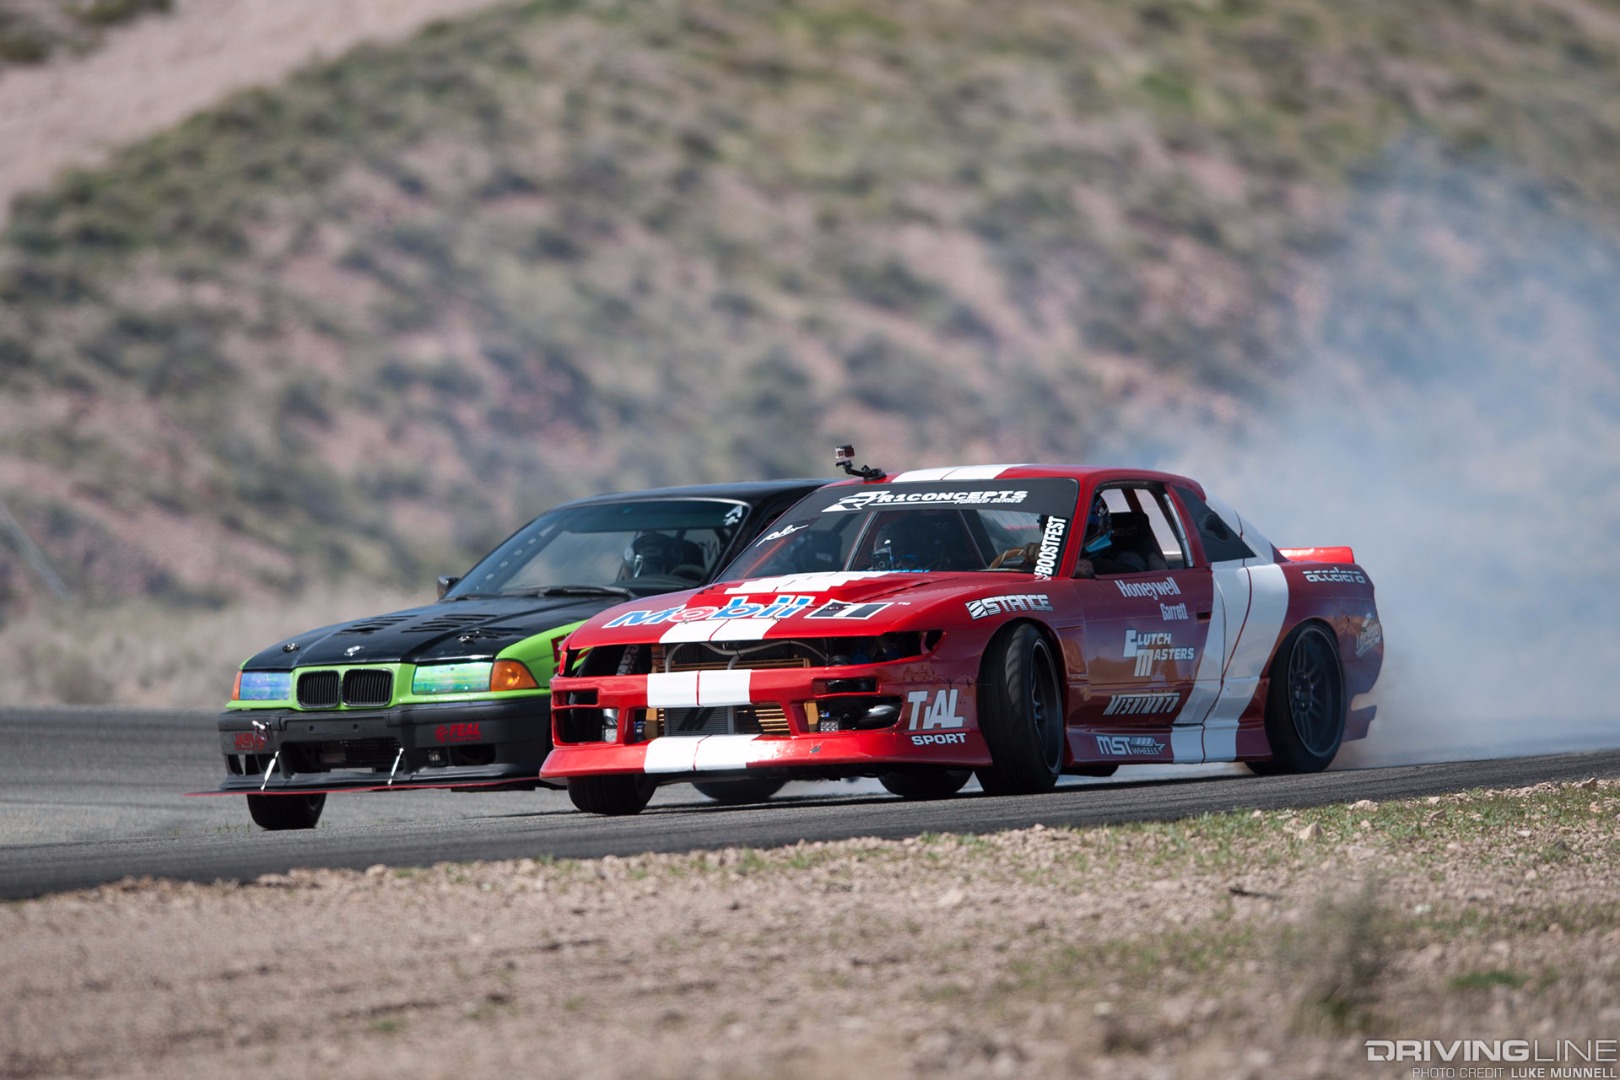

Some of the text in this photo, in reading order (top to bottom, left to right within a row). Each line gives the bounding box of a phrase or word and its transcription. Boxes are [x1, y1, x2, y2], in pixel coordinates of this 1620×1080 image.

[1114, 576, 1181, 601] Honeywell
[601, 595, 816, 628] Mobil
[981, 594, 1054, 616] STANCE
[1160, 603, 1188, 621] Garrett
[1123, 629, 1171, 657] CLUTCH
[1133, 646, 1195, 677] MASTERS
[1102, 692, 1180, 716] MISHIMOTO
[449, 722, 481, 737] FEAL
[911, 732, 966, 746] SPORT
[1096, 735, 1133, 755] MST
[1131, 747, 1160, 755] WHEELS
